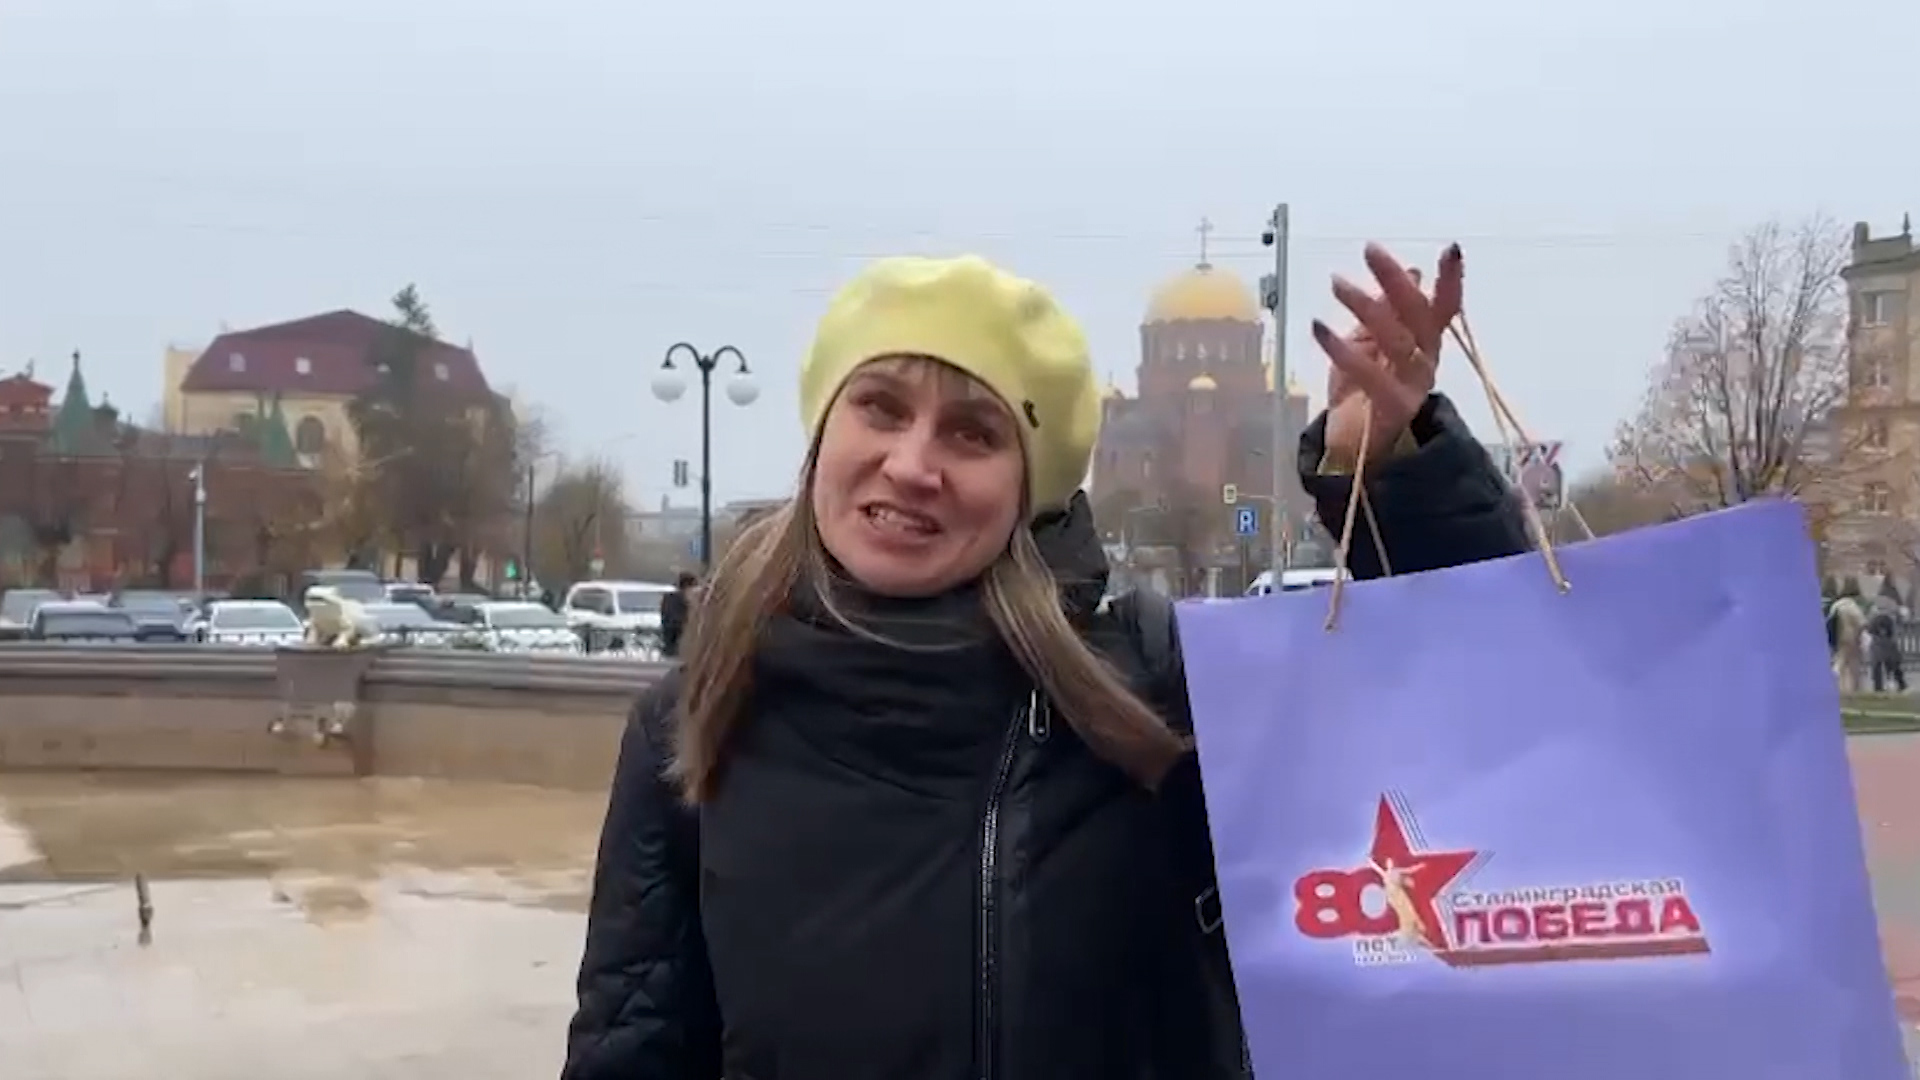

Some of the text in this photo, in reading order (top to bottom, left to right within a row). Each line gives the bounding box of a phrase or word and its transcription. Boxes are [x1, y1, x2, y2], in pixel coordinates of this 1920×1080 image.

[1294, 867, 1400, 938] 80
[1453, 879, 1682, 906] Сталинградская
[1455, 896, 1701, 944] ПОБЕДА
